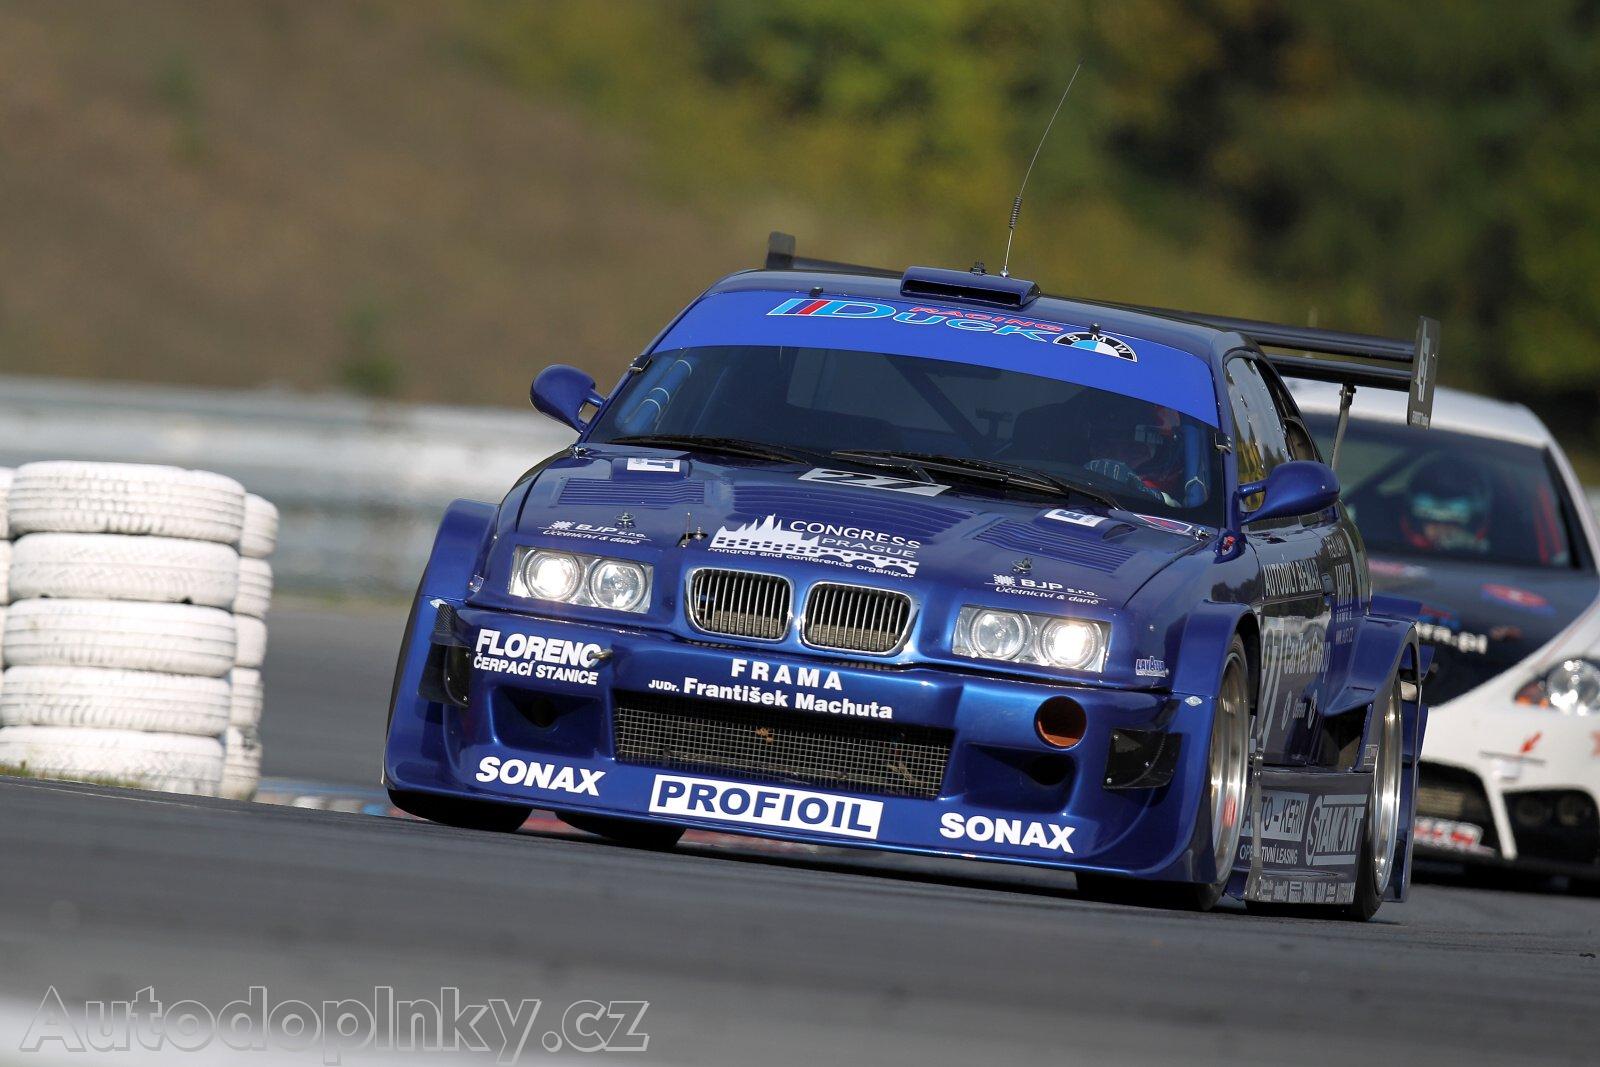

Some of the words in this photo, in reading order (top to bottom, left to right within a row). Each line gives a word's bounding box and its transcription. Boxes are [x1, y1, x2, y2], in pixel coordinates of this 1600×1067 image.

[909, 306, 1063, 332] RACING
[1065, 333, 1131, 355] BMW
[574, 523, 618, 534] BJP
[789, 520, 921, 549] CONGRESS
[820, 537, 918, 559] PRAGUE
[759, 550, 783, 559] and
[785, 553, 853, 569] conference
[856, 563, 915, 579] organizer
[1020, 578, 1063, 590] BJP
[1067, 587, 1099, 597] s.r.o.
[1056, 593, 1066, 601] &
[1068, 595, 1099, 605] daně
[475, 628, 601, 668] FLORENC
[473, 651, 535, 677] ČERPACÍ
[535, 664, 599, 686] STANICE
[730, 658, 843, 691] FRAMA
[648, 679, 680, 692] JUDr.
[683, 676, 788, 708] František
[794, 692, 893, 719] Machuta
[475, 756, 606, 797] SONAX
[656, 780, 873, 832] PROFIOIL
[939, 812, 1077, 854] SONAX
[1305, 795, 1366, 867] STAMONT
